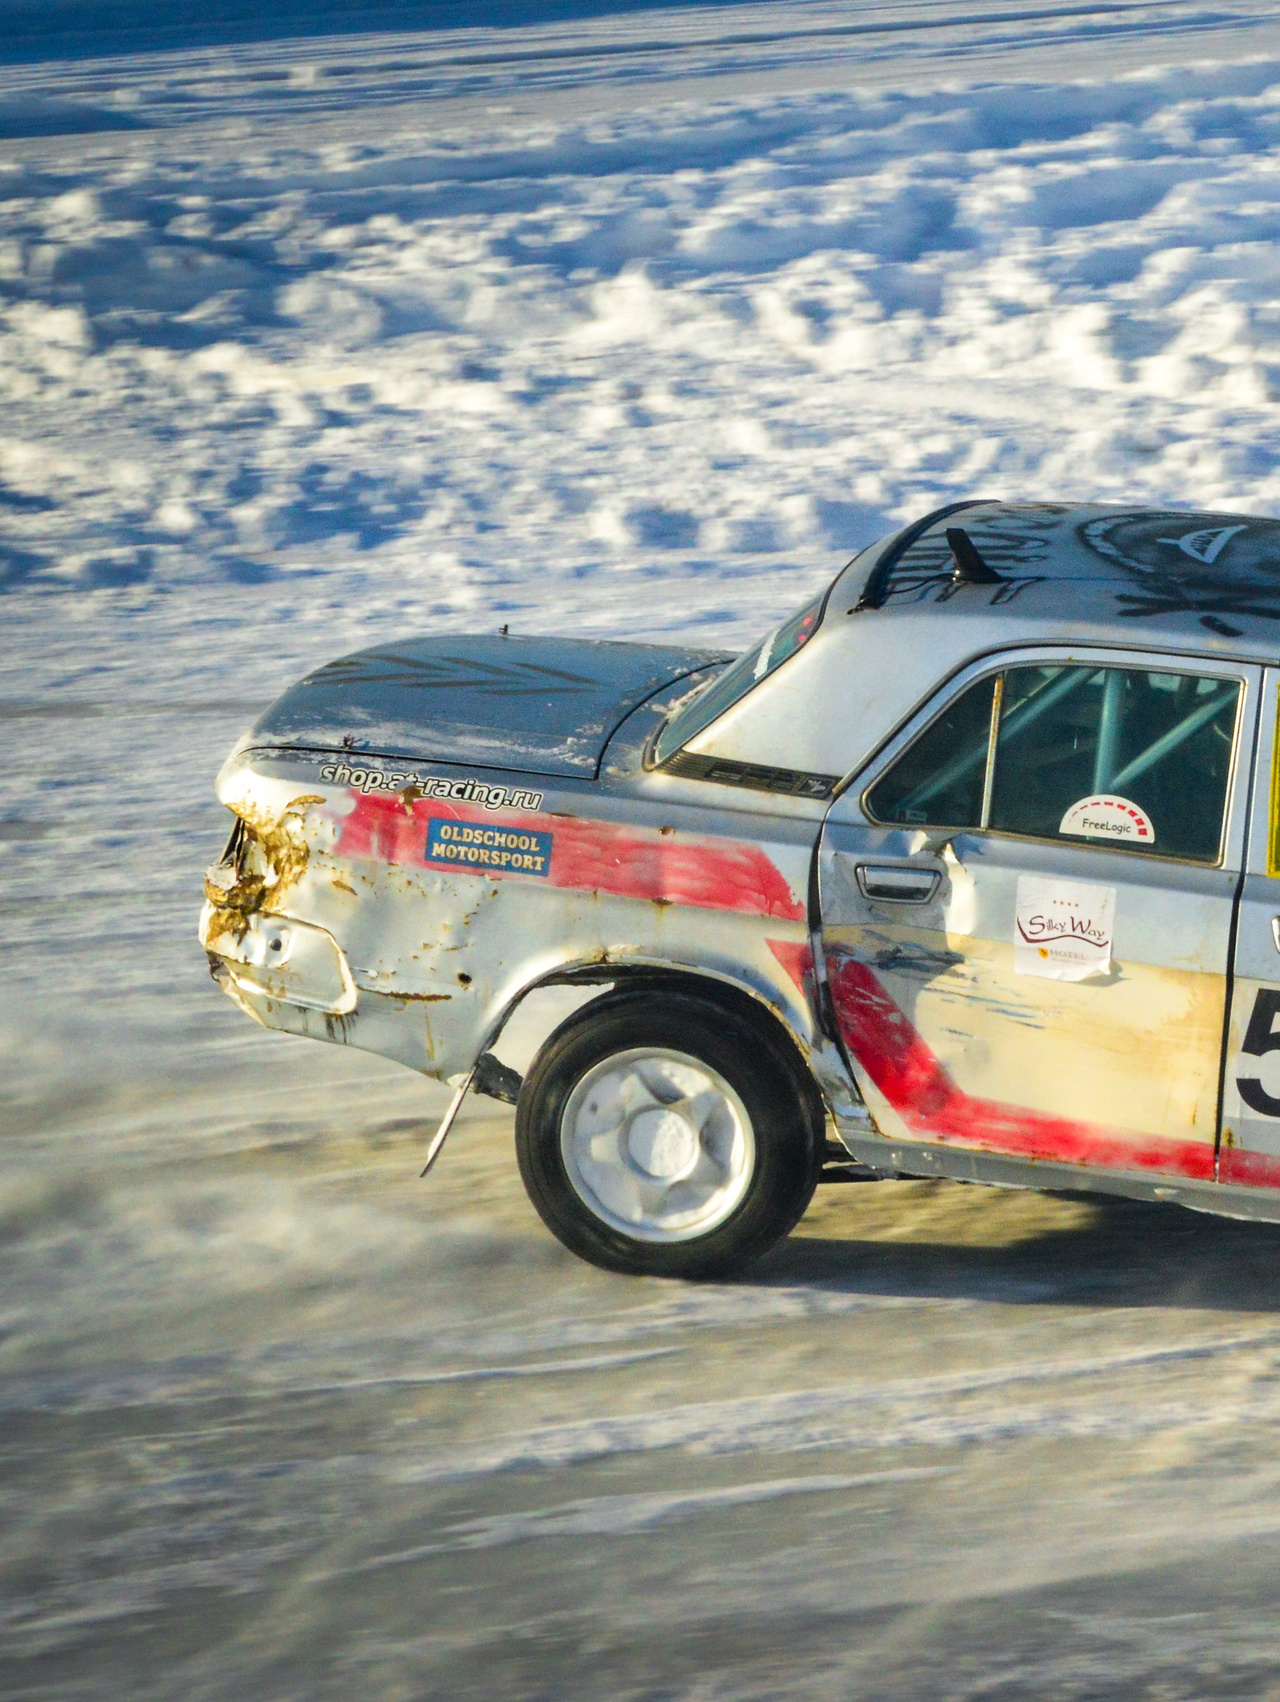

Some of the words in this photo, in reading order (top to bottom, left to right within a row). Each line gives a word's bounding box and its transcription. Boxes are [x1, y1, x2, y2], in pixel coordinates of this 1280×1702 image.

[440, 825, 541, 851] OLDSCHOOL
[1082, 818, 1131, 834] FreeLogic
[431, 842, 545, 871] MOTORSPORT
[1028, 915, 1066, 935] Silky
[1070, 916, 1105, 940] Way
